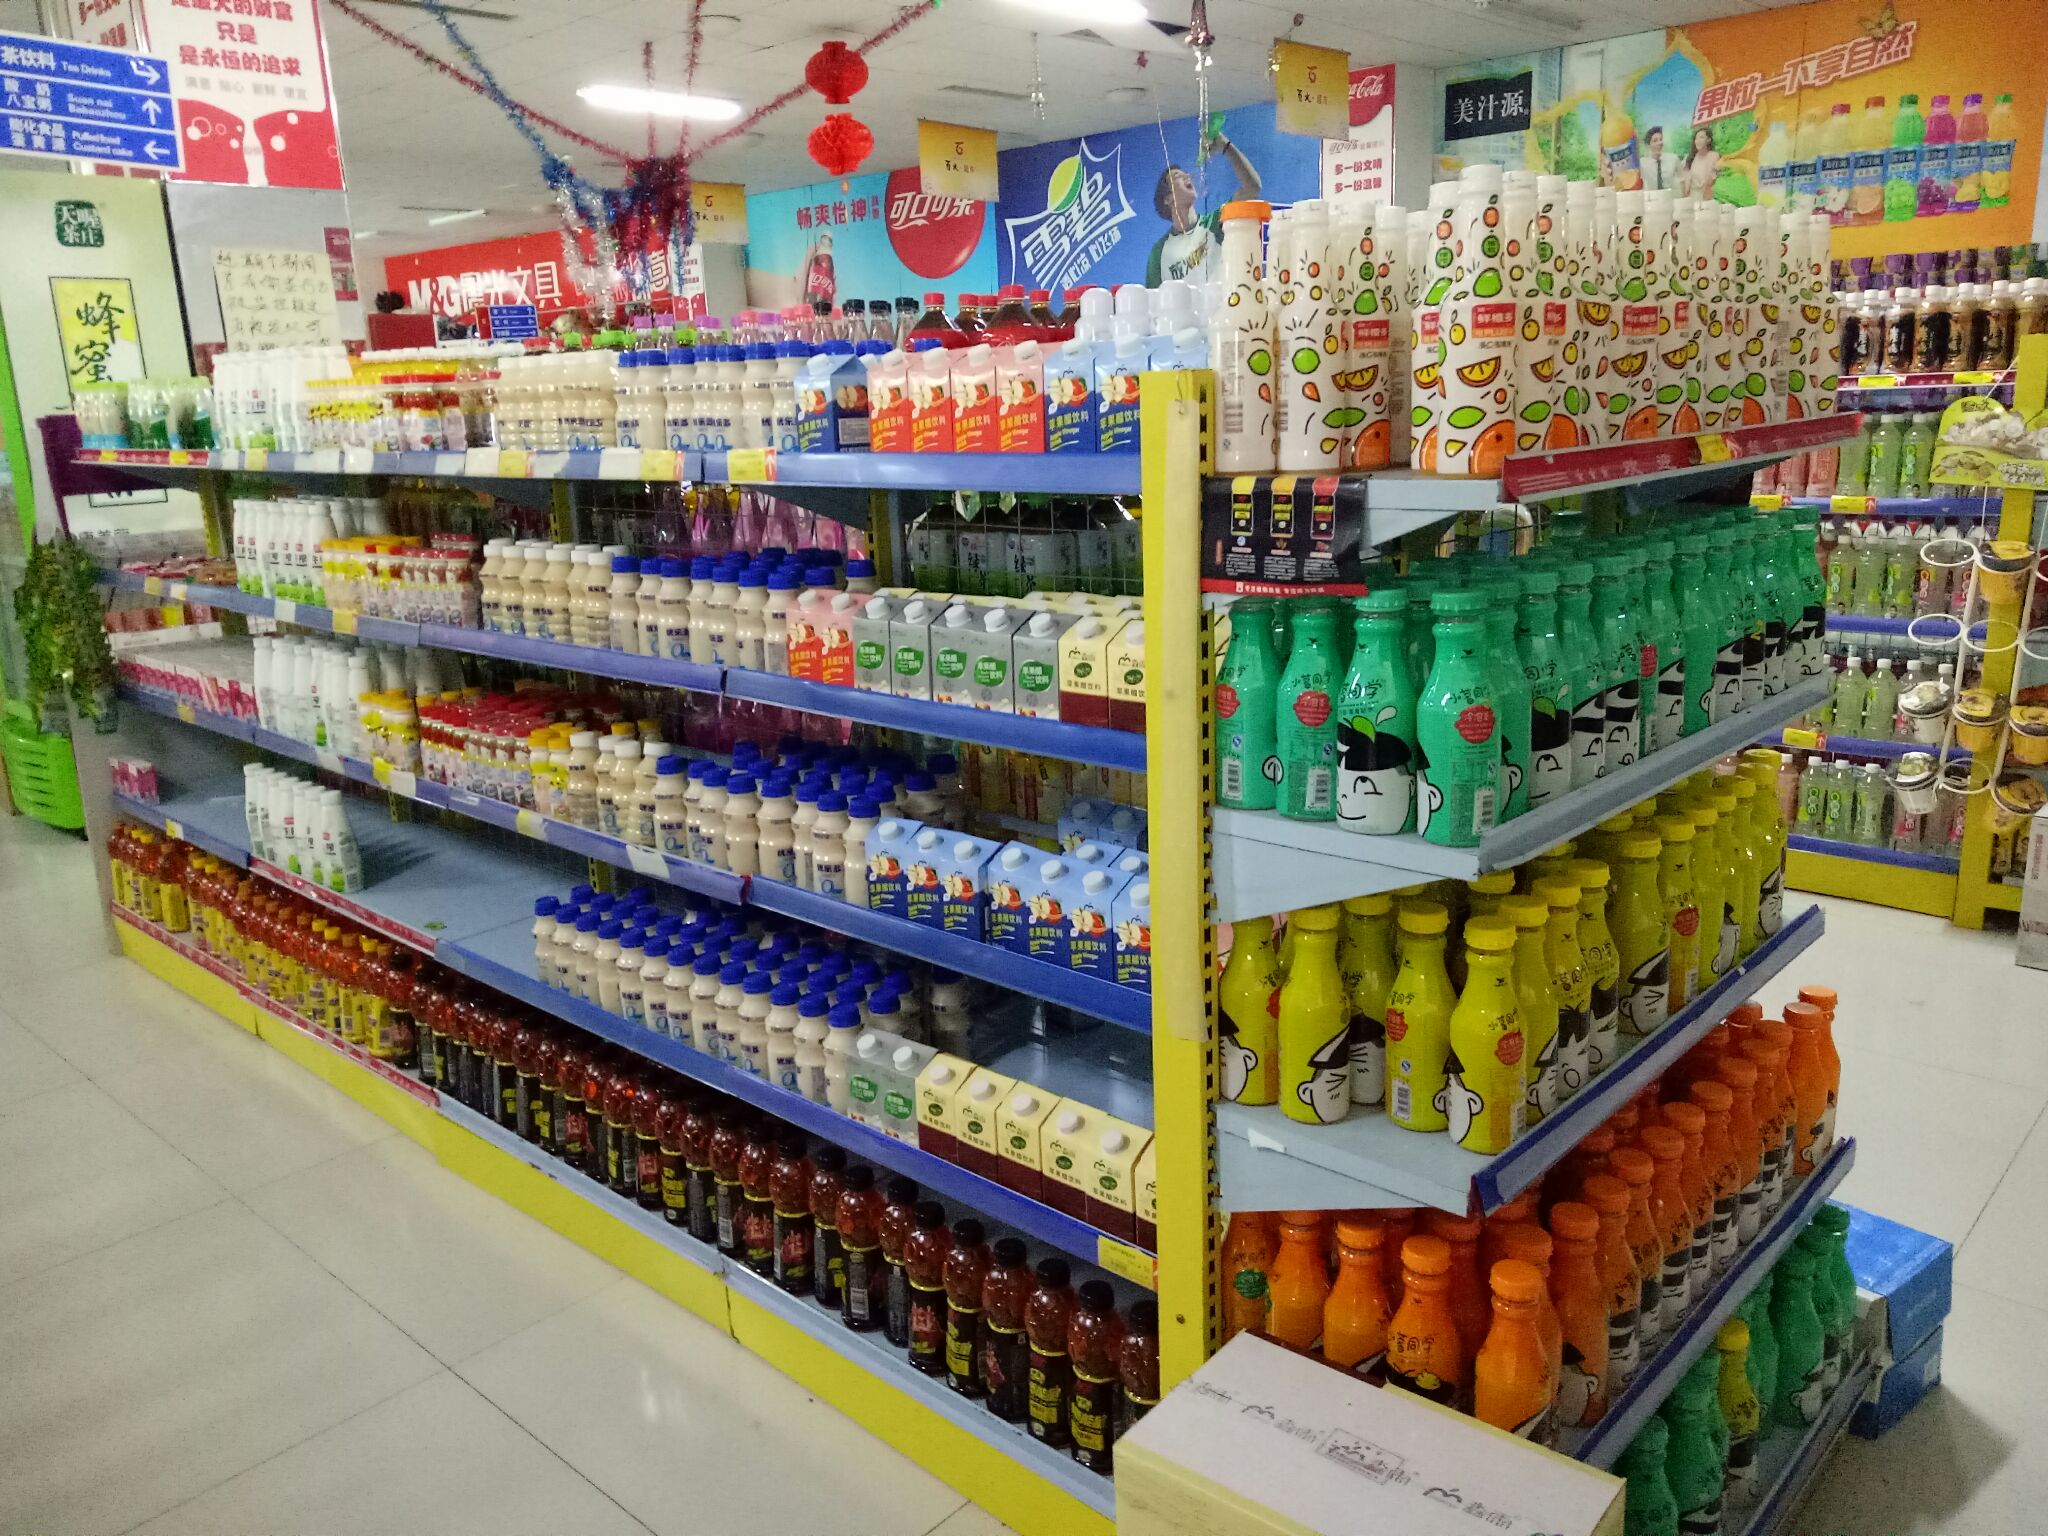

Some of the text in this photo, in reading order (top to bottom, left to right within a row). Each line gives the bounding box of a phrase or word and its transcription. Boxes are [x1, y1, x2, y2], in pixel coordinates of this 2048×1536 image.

[216, 21, 258, 44] 只是
[179, 45, 302, 76] 是永恒的追求
[1453, 89, 1525, 126] 美汁源
[1334, 158, 1382, 176] 多一份文明
[796, 198, 867, 230] 畅爽怡神
[1020, 166, 1112, 290] 雪碧
[71, 291, 125, 383] 蜂蜜
